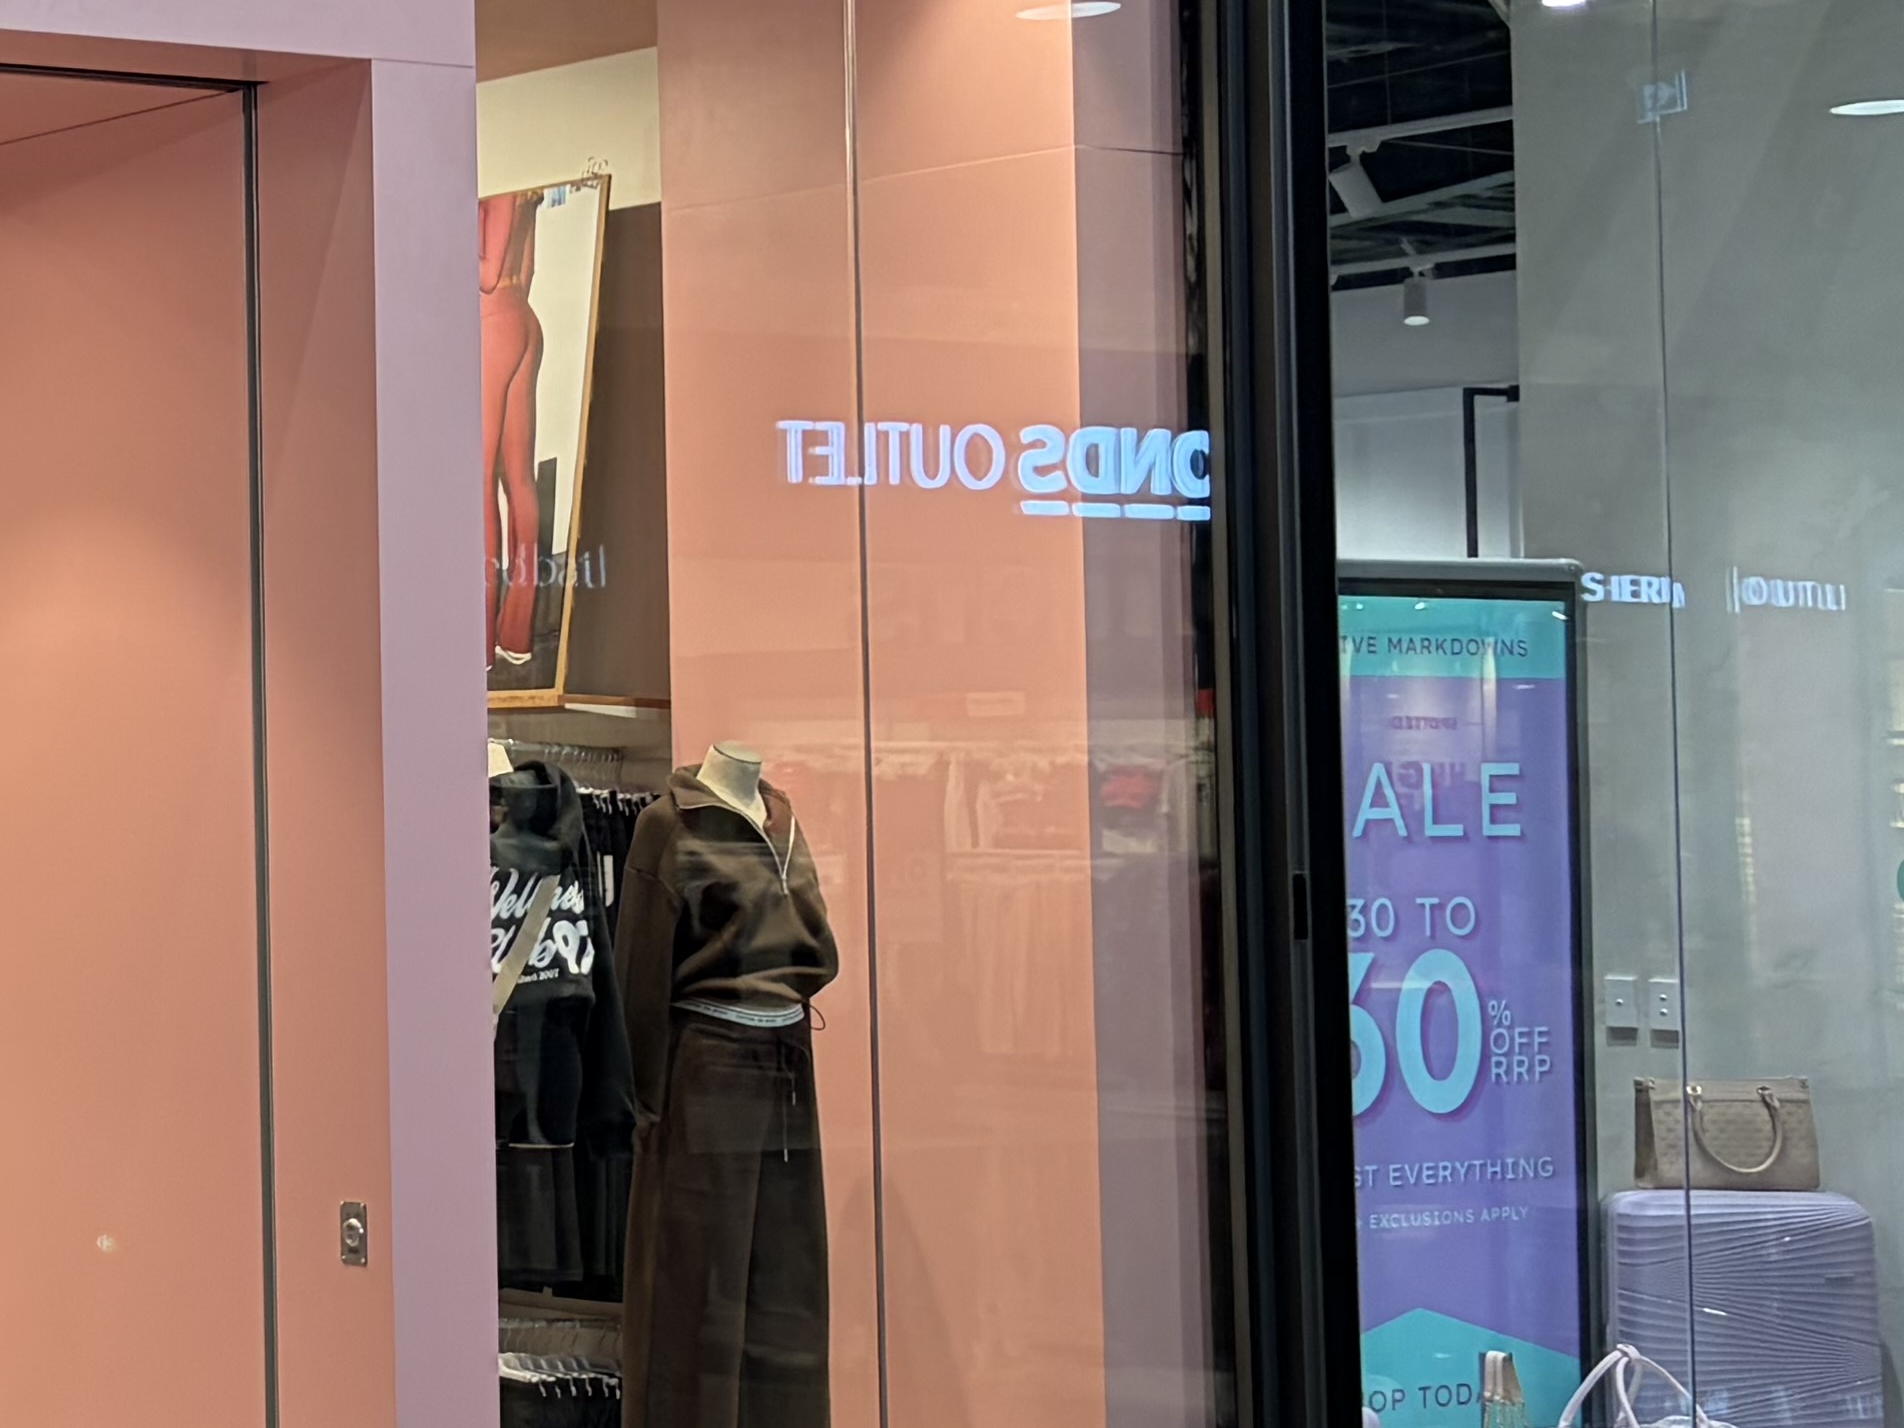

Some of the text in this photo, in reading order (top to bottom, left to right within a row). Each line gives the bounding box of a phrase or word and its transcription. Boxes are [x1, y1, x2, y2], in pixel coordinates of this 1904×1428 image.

[1387, 636, 1530, 658] MARKDOWNS
[1351, 761, 1523, 839] ALE
[1415, 895, 1476, 937] TO
[1490, 1026, 1550, 1054] OFF
[1491, 1054, 1551, 1083] RRP
[1388, 1156, 1554, 1187] EVERYTHING
[1369, 1205, 1529, 1230] EXCLUSIONS APPLY
[1417, 1382, 1482, 1409] TOD
